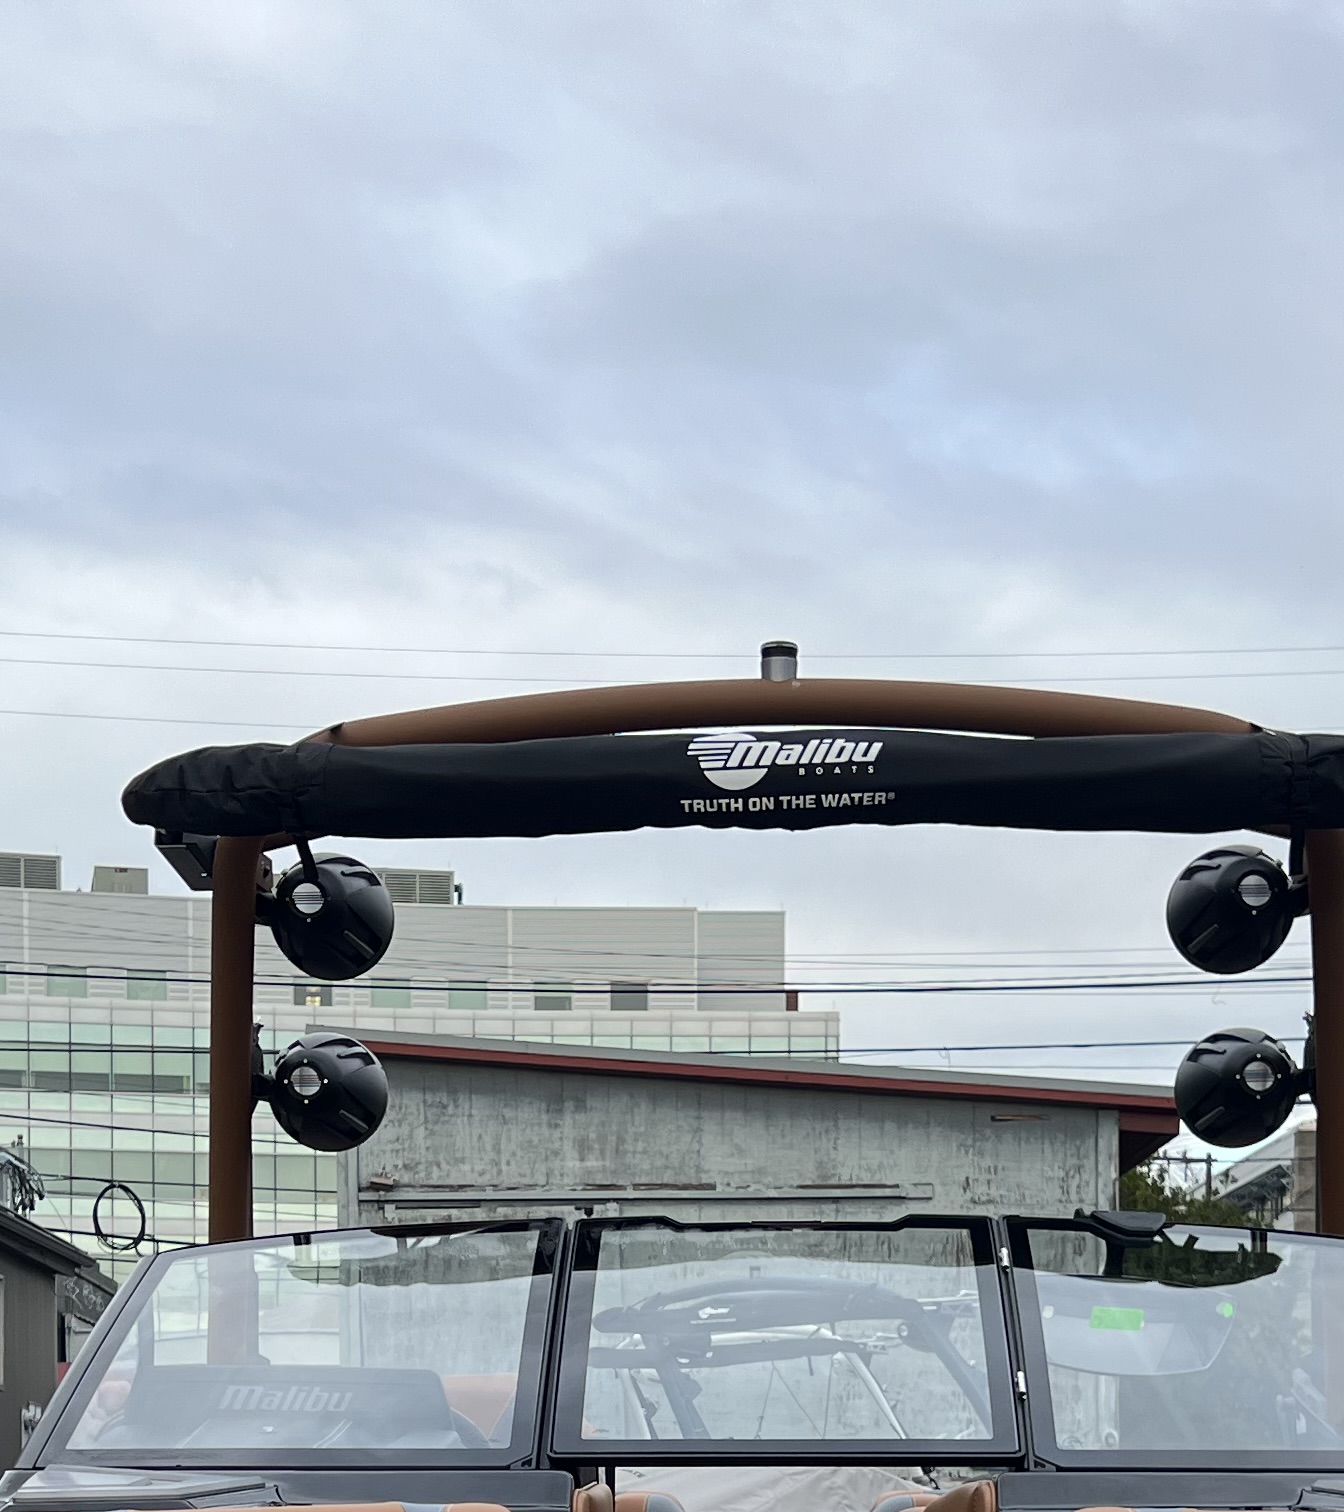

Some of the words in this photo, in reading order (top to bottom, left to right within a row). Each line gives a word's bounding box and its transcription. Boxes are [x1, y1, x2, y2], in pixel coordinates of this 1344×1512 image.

[798, 765, 875, 776] BOATS
[679, 798, 744, 813] TRUTH
[748, 797, 774, 812] ON
[779, 795, 817, 809] THE
